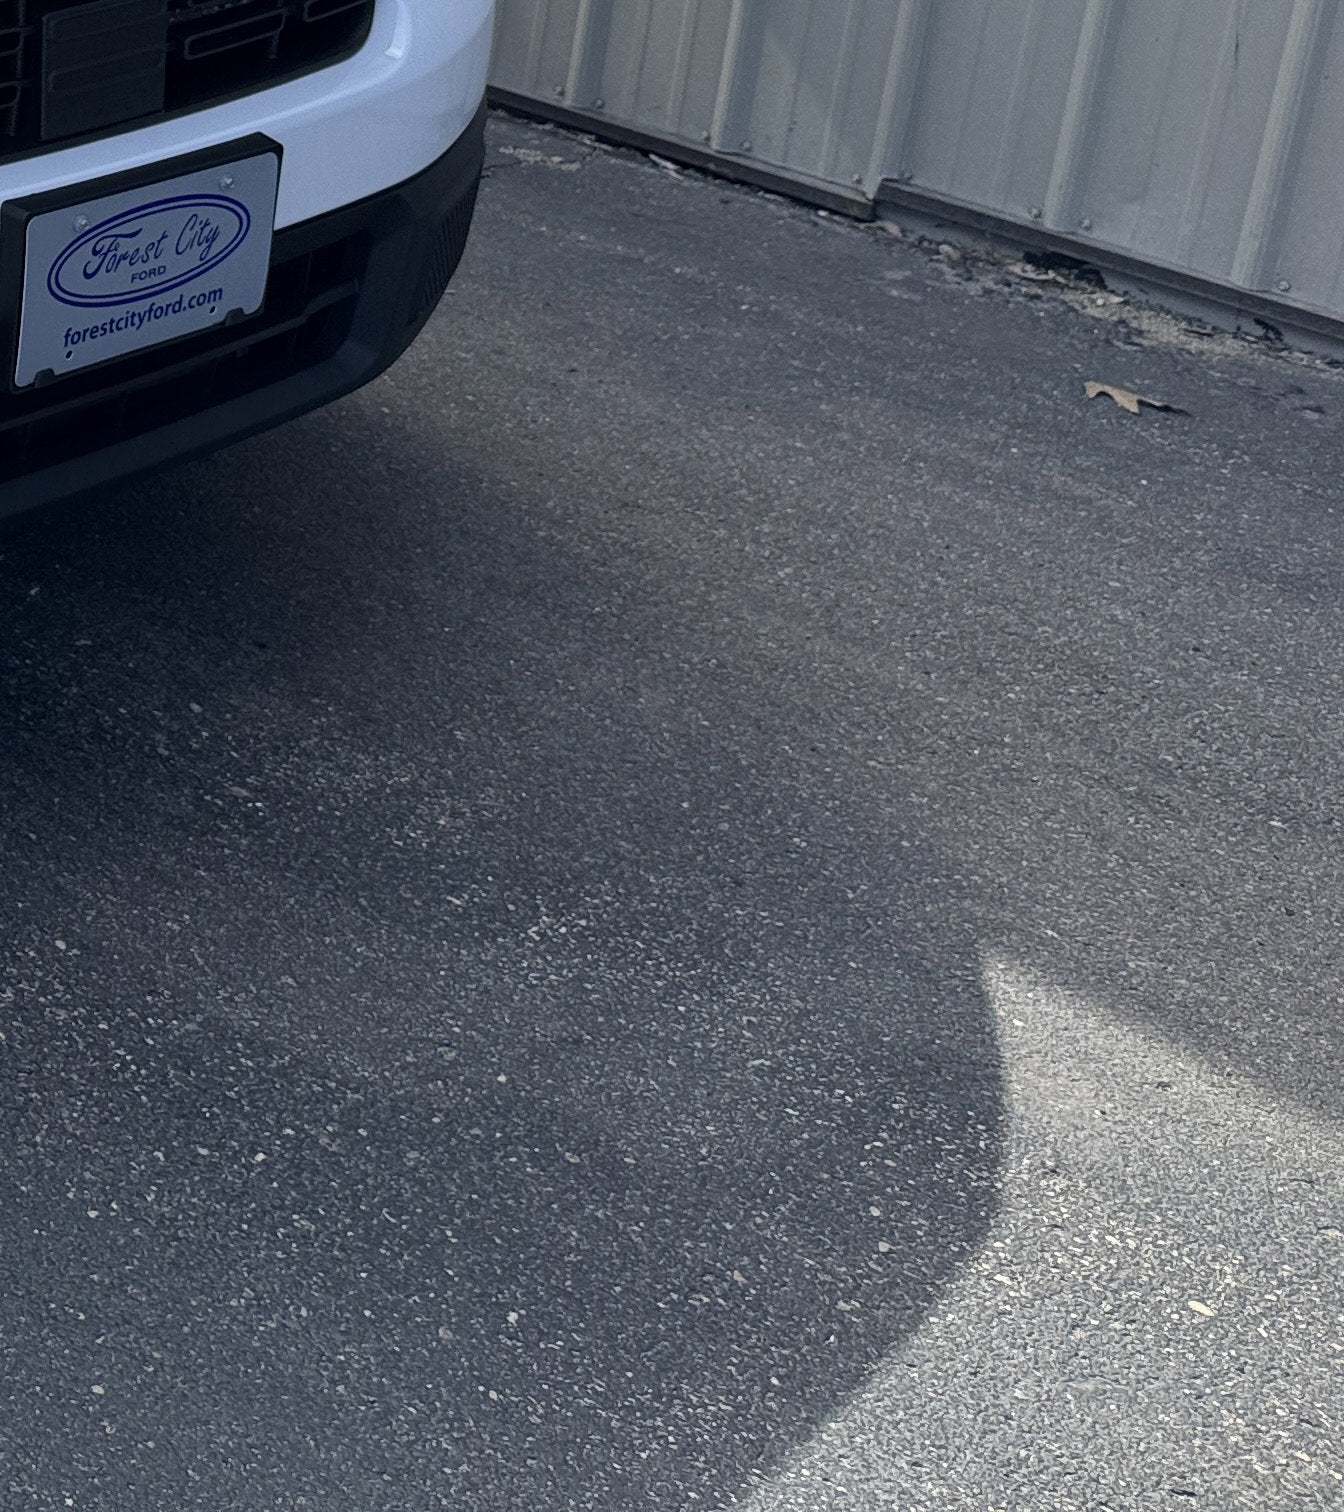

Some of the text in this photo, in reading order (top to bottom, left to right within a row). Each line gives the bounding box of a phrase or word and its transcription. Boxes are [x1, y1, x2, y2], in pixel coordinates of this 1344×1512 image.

[83, 213, 220, 279] Forest City
[130, 265, 167, 283] FORD
[64, 287, 223, 348] forestcityford.com
